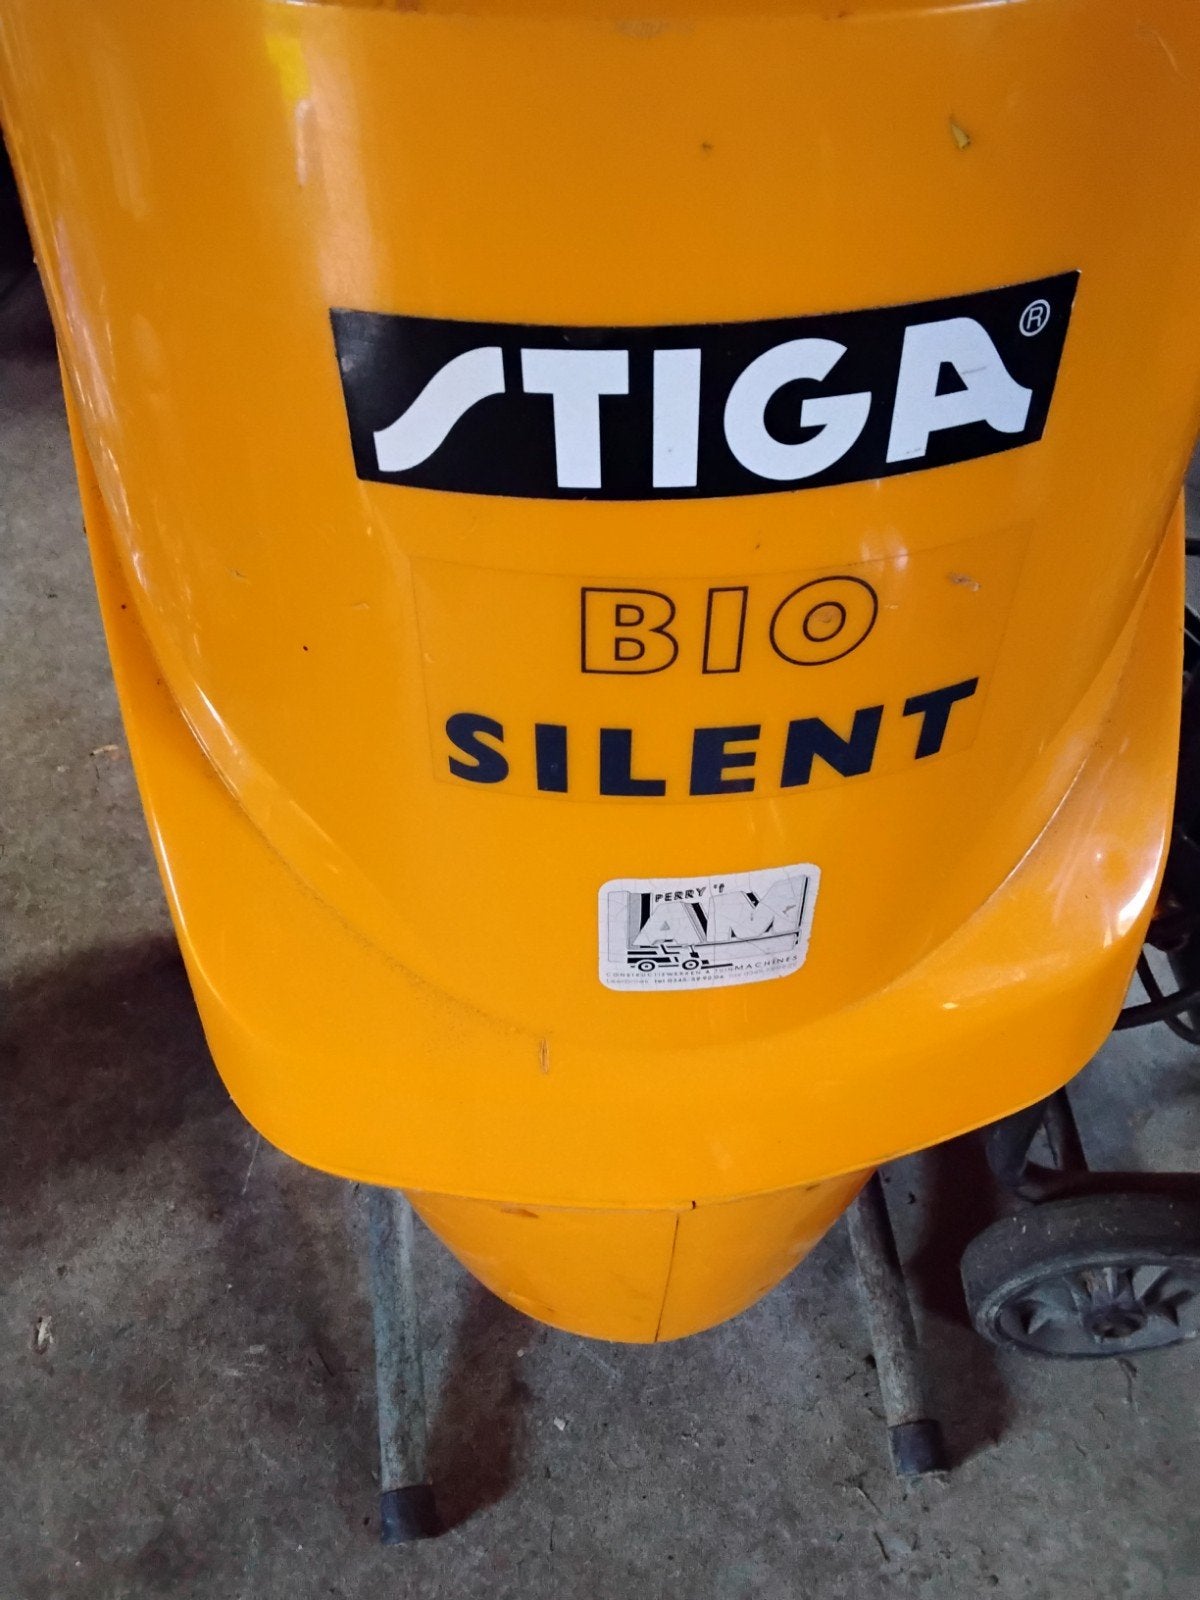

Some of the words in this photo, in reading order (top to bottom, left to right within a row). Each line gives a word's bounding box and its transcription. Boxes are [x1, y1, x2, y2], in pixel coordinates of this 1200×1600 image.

[373, 317, 1034, 489] STIGA
[580, 574, 879, 674] BIO
[445, 676, 979, 797] SILENT
[654, 886, 707, 903] PERRY
